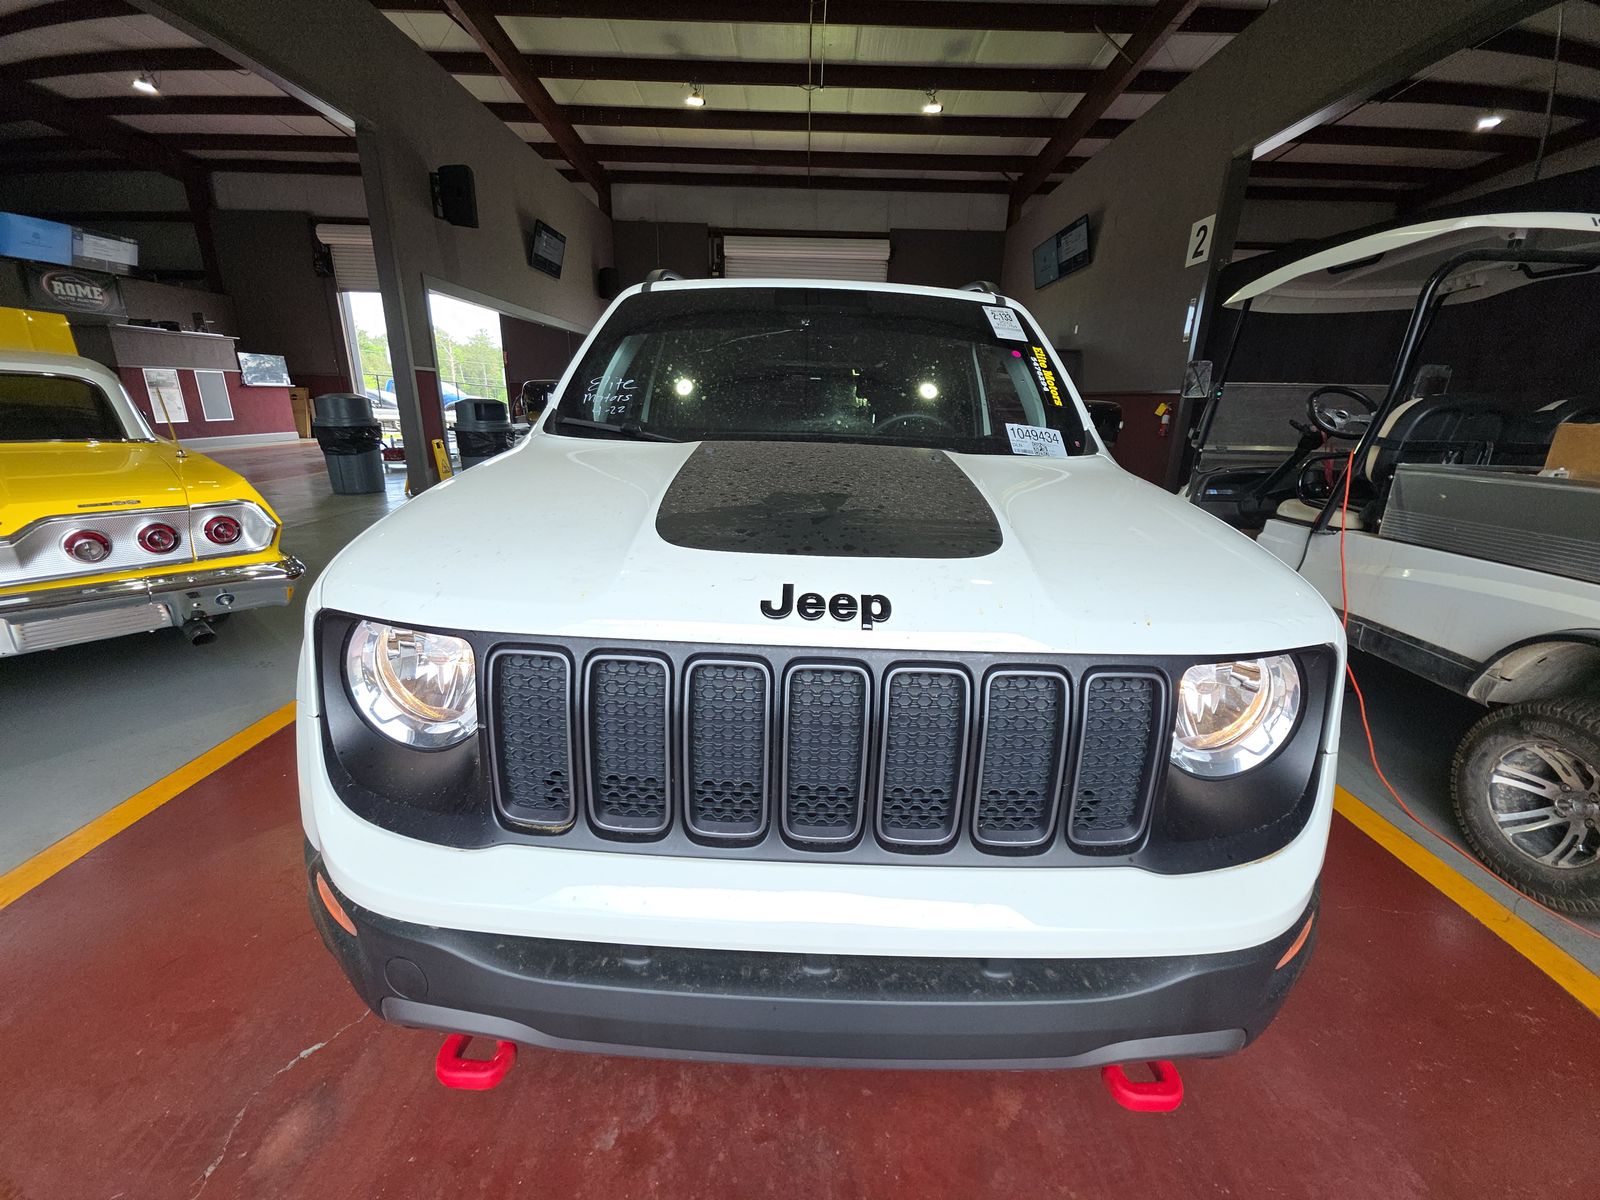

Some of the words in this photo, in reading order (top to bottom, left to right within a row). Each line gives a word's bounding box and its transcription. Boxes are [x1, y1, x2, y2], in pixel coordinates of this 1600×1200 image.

[1192, 224, 1208, 259] 2
[51, 280, 103, 300] ROME
[1032, 346, 1048, 369] Elite
[1042, 369, 1063, 407] Motors
[1010, 427, 1060, 444] 1049434
[760, 583, 892, 631] Jeep
